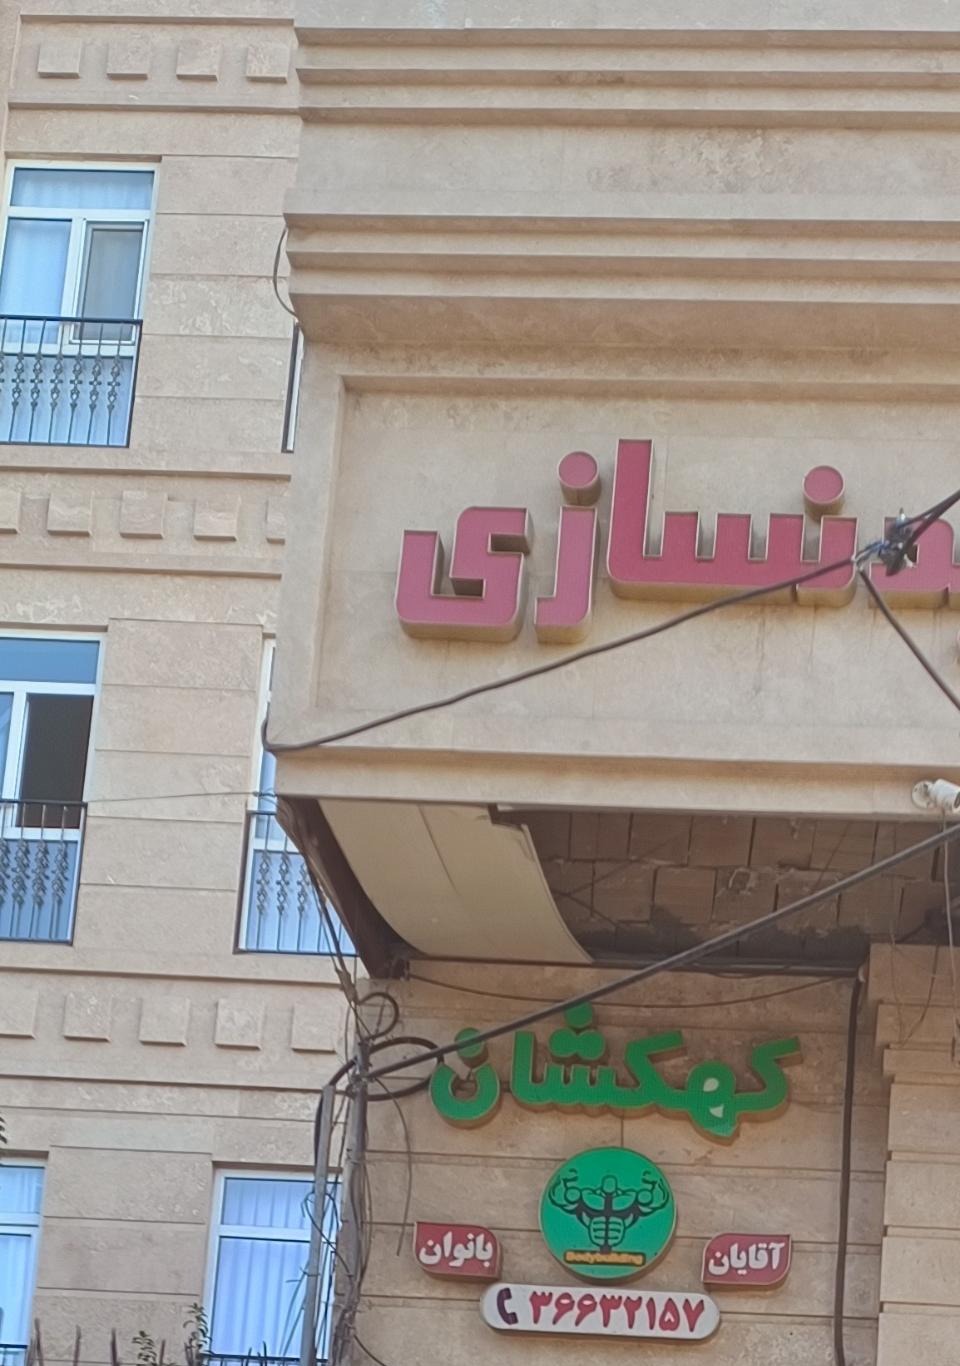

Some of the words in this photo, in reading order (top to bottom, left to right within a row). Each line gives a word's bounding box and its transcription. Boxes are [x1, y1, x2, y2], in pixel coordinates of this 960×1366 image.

[429, 1001, 800, 1142] کهکشان
[419, 1231, 493, 1267] بانوان
[708, 1242, 785, 1276] آقایان
[529, 1290, 705, 1333] ۳۶۶۳۲۱۵۷
